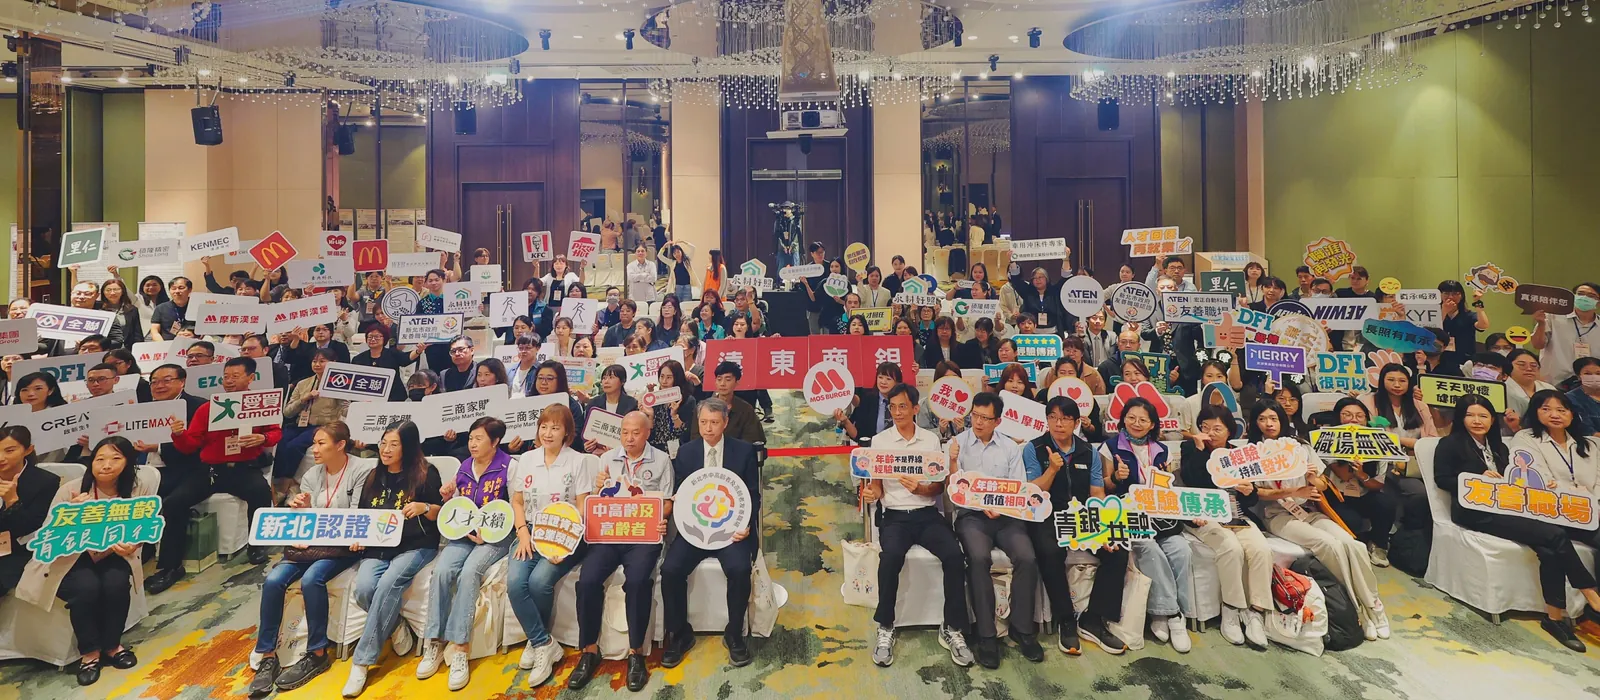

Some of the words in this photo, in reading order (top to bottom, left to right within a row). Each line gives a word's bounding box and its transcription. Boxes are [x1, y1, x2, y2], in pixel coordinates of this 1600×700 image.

[66, 240, 97, 256] 里仁
[190, 237, 229, 251] KENMEC
[571, 242, 595, 253] Pizza
[572, 249, 590, 258] Hut
[1209, 276, 1238, 292] 里仁
[1068, 290, 1098, 299] ATEN
[1122, 286, 1150, 298] ATEN
[1521, 293, 1568, 307] 真承陪伴您
[219, 315, 259, 324] 摩斯漢堡
[289, 305, 329, 320] 摩斯漢堡
[1237, 308, 1275, 331] DFI
[66, 319, 100, 332] 全聯
[409, 317, 435, 325] ATEN
[1318, 353, 1366, 376] DFI
[40, 363, 85, 382] DFI
[355, 378, 382, 391] 全聯
[938, 384, 951, 397] 我
[1319, 376, 1368, 391] 很可以
[810, 394, 825, 403] MOS
[825, 390, 851, 400] BURGER
[929, 393, 966, 416] 摩斯漢堡
[41, 411, 90, 432] CREA
[237, 408, 282, 420] a.mart
[441, 415, 461, 423] Simple
[505, 408, 544, 424] 三商家
[125, 416, 171, 431] LITEMAX
[1021, 414, 1049, 432] 摩斯
[1313, 431, 1408, 456] 職場無限
[875, 454, 923, 464] 年齡不是界線
[1219, 445, 1261, 468] 讓經驗
[874, 465, 923, 475] 經驗就是價值
[1238, 455, 1290, 479] 持續發光
[975, 479, 1018, 493] 年齡不同
[983, 493, 1027, 508] 價值相同
[1134, 487, 1228, 516] 經驗傳承
[1463, 478, 1593, 524] 友善職場
[52, 499, 157, 527] 友善無齡
[592, 503, 654, 518] 中高齡及
[260, 513, 371, 539] 新北認證
[445, 509, 506, 529] 人才永續
[1055, 506, 1151, 546] 青銀共融
[600, 522, 647, 537] 高齡者
[35, 519, 162, 560] 青銀同行
